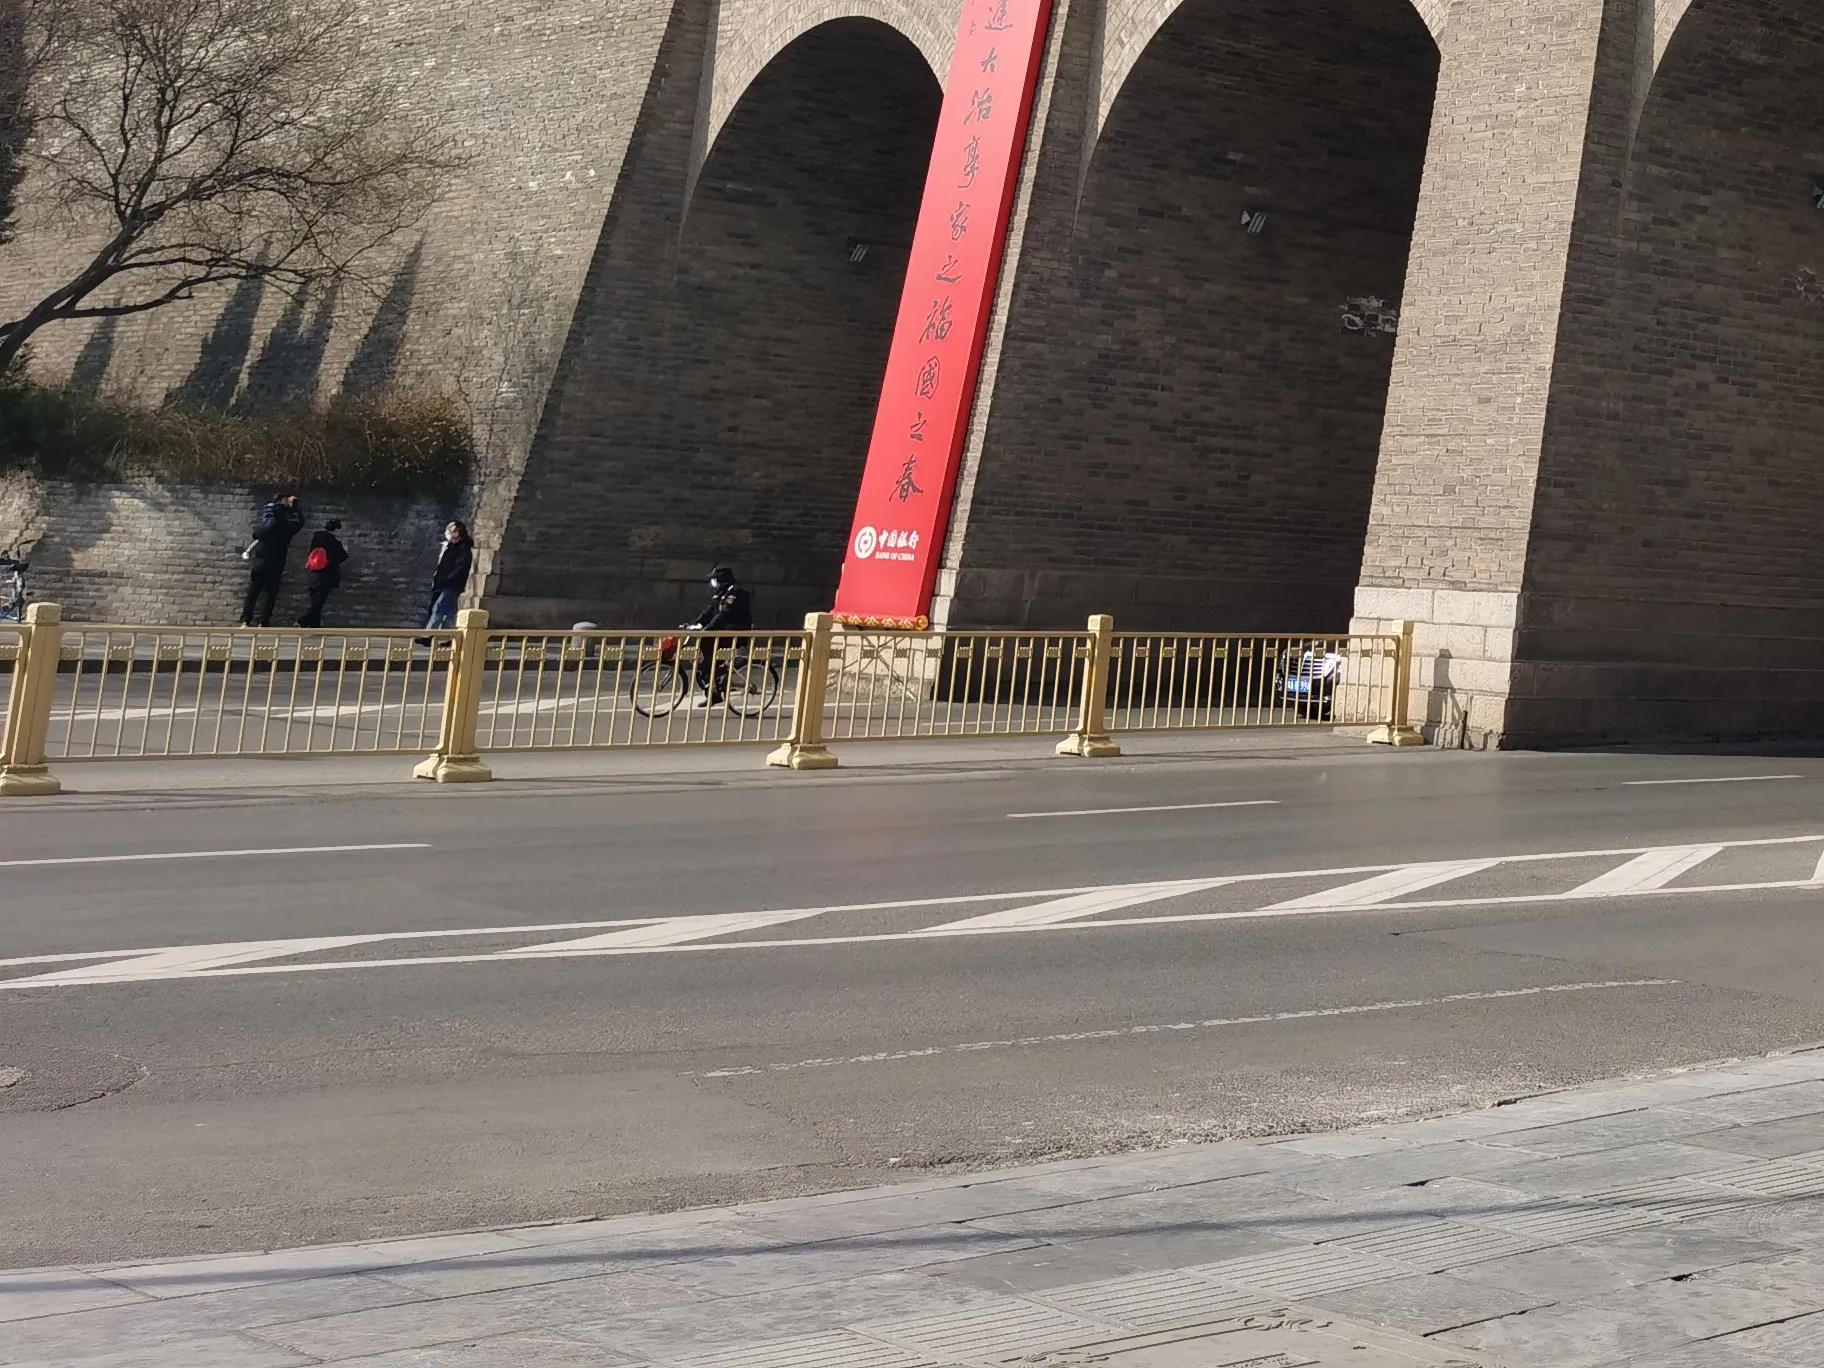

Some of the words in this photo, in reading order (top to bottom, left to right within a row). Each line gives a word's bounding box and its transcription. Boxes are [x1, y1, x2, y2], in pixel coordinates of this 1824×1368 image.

[875, 551, 890, 560] BANK
[890, 552, 899, 560] OF
[898, 552, 915, 561] CHINA
